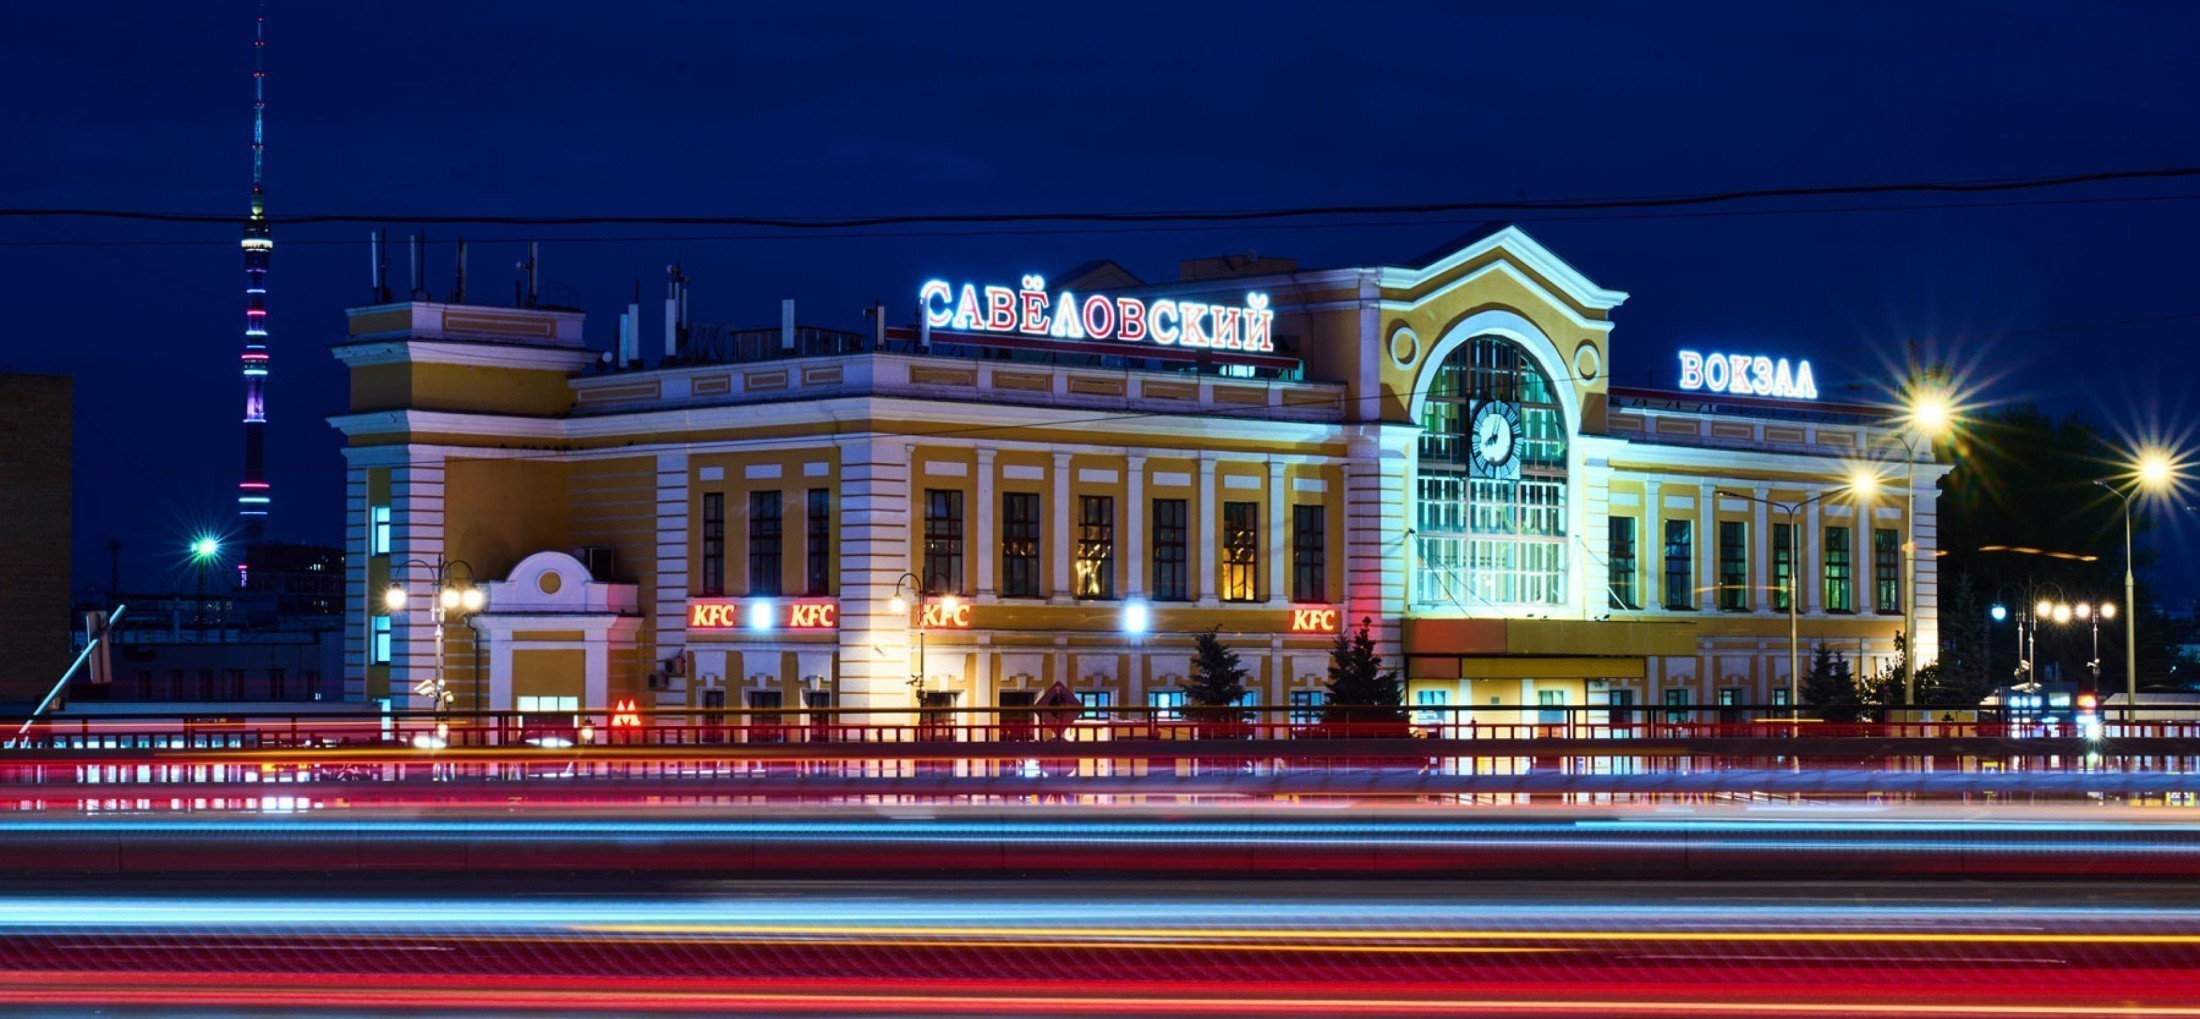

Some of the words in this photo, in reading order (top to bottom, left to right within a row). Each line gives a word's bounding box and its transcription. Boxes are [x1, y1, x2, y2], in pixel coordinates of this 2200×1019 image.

[920, 275, 1273, 351] САВЁЛОВСКИЙ
[1679, 350, 1817, 398] ВОКЗАЛ
[692, 604, 734, 627] KFC
[790, 604, 835, 627] KFC
[1292, 609, 1335, 631] KFC
